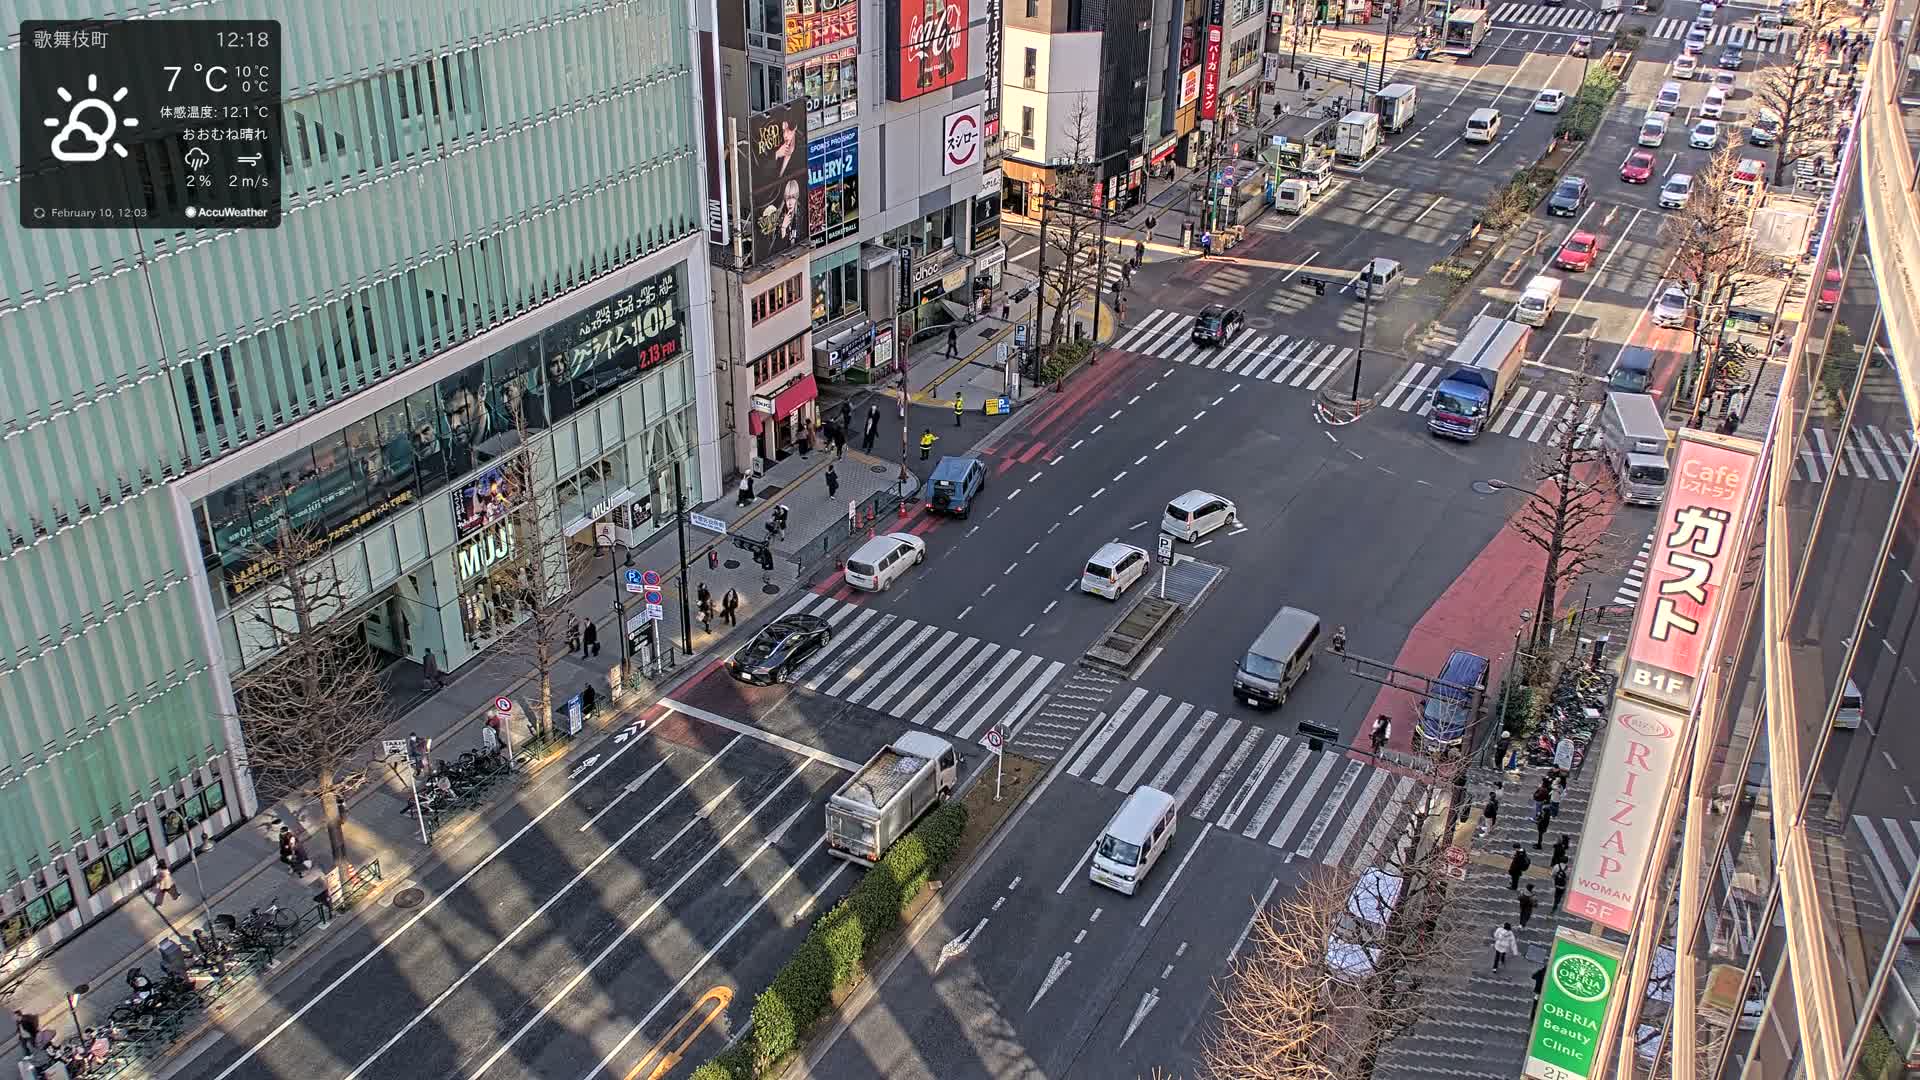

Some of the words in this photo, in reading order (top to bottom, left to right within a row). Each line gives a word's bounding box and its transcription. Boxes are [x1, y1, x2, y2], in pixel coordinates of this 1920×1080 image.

[908, 4, 961, 62] Coca-Cola
[1205, 45, 1219, 109] バーガーキング
[810, 141, 829, 153] SPORTS
[831, 135, 841, 147] PRO
[842, 132, 856, 142] SHOP
[946, 132, 978, 152] スシロー
[710, 199, 721, 232] MUJI
[828, 223, 857, 239] BASKETBALL
[902, 249, 909, 258] P
[595, 305, 610, 320] クリス
[614, 303, 634, 319] ラファロ
[618, 295, 633, 309] マーク
[1017, 325, 1025, 334] P
[640, 343, 659, 369] 2.13
[662, 340, 676, 357] FRI
[829, 351, 839, 366] P
[999, 398, 1005, 408] P
[1682, 459, 1739, 488] Café
[1680, 478, 1735, 500] レストラン
[592, 496, 614, 520] MUJI
[459, 523, 514, 581] MUJI
[1161, 539, 1168, 547] P
[629, 573, 635, 581] P
[1650, 506, 1730, 641] ガスト
[1633, 668, 1684, 693] B1F
[1598, 740, 1651, 880] RIZAP
[1579, 877, 1631, 903] WOMAN
[1585, 900, 1613, 919] 5F
[1559, 968, 1601, 990] OBERIA
[1543, 1002, 1599, 1031] OBERIA
[1543, 1019, 1591, 1045] Beauty
[1542, 1037, 1584, 1060] Clinic
[1543, 1066, 1568, 1080] 2F
